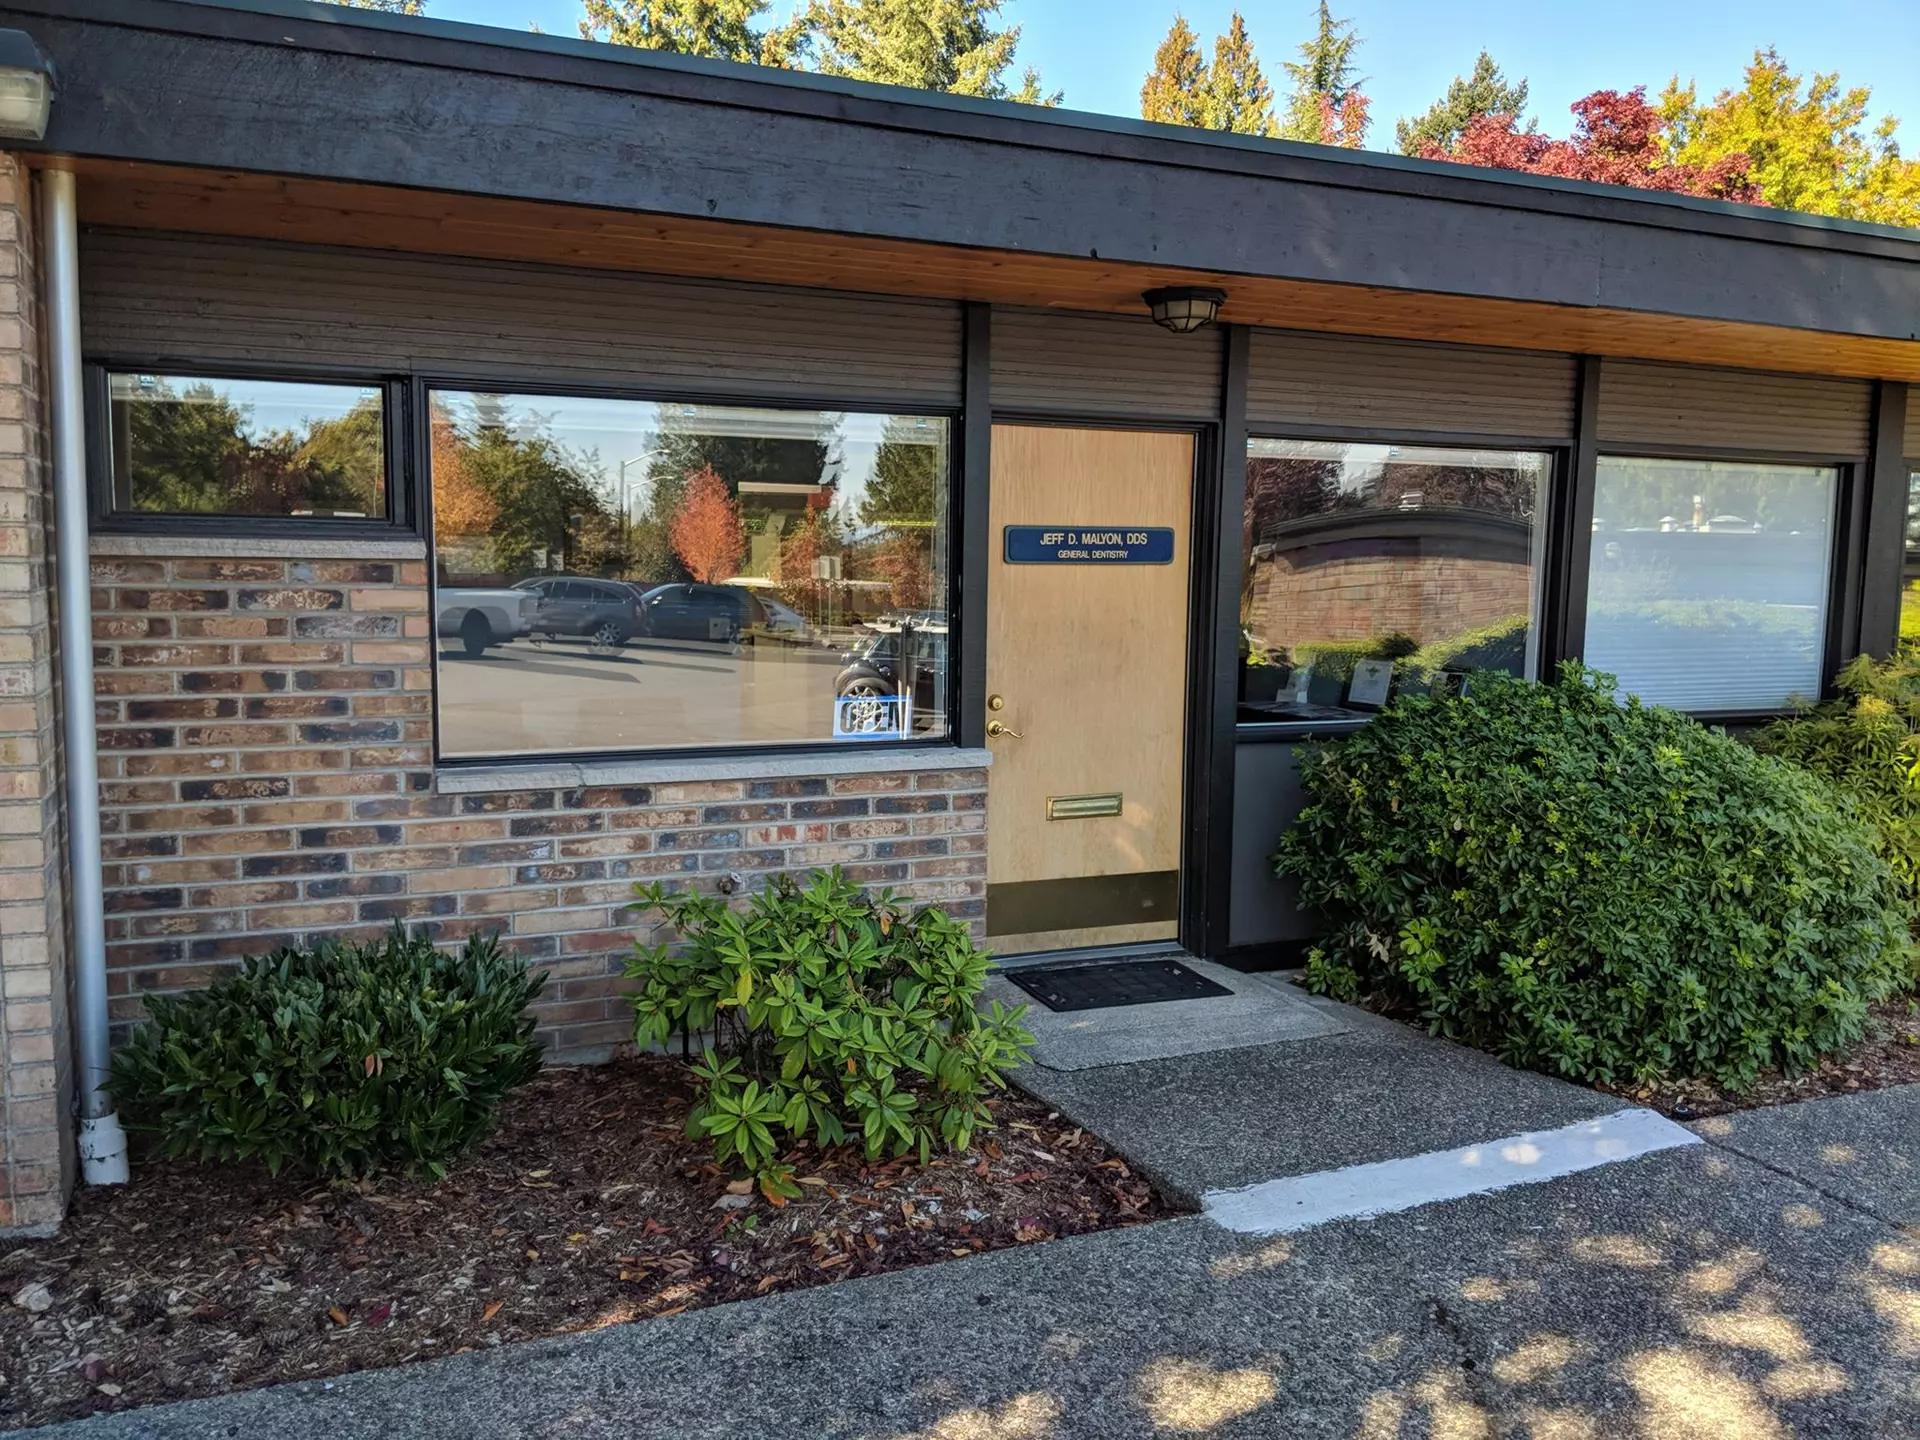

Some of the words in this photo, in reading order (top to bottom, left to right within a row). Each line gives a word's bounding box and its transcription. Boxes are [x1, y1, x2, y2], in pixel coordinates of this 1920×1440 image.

[1040, 533, 1064, 545] JEFF
[1068, 533, 1078, 545] D.
[1082, 533, 1123, 546] MALYON,
[1127, 533, 1147, 545] DDS
[1058, 550, 1089, 559] GENERAL
[1092, 550, 1128, 559] DENTISTRY
